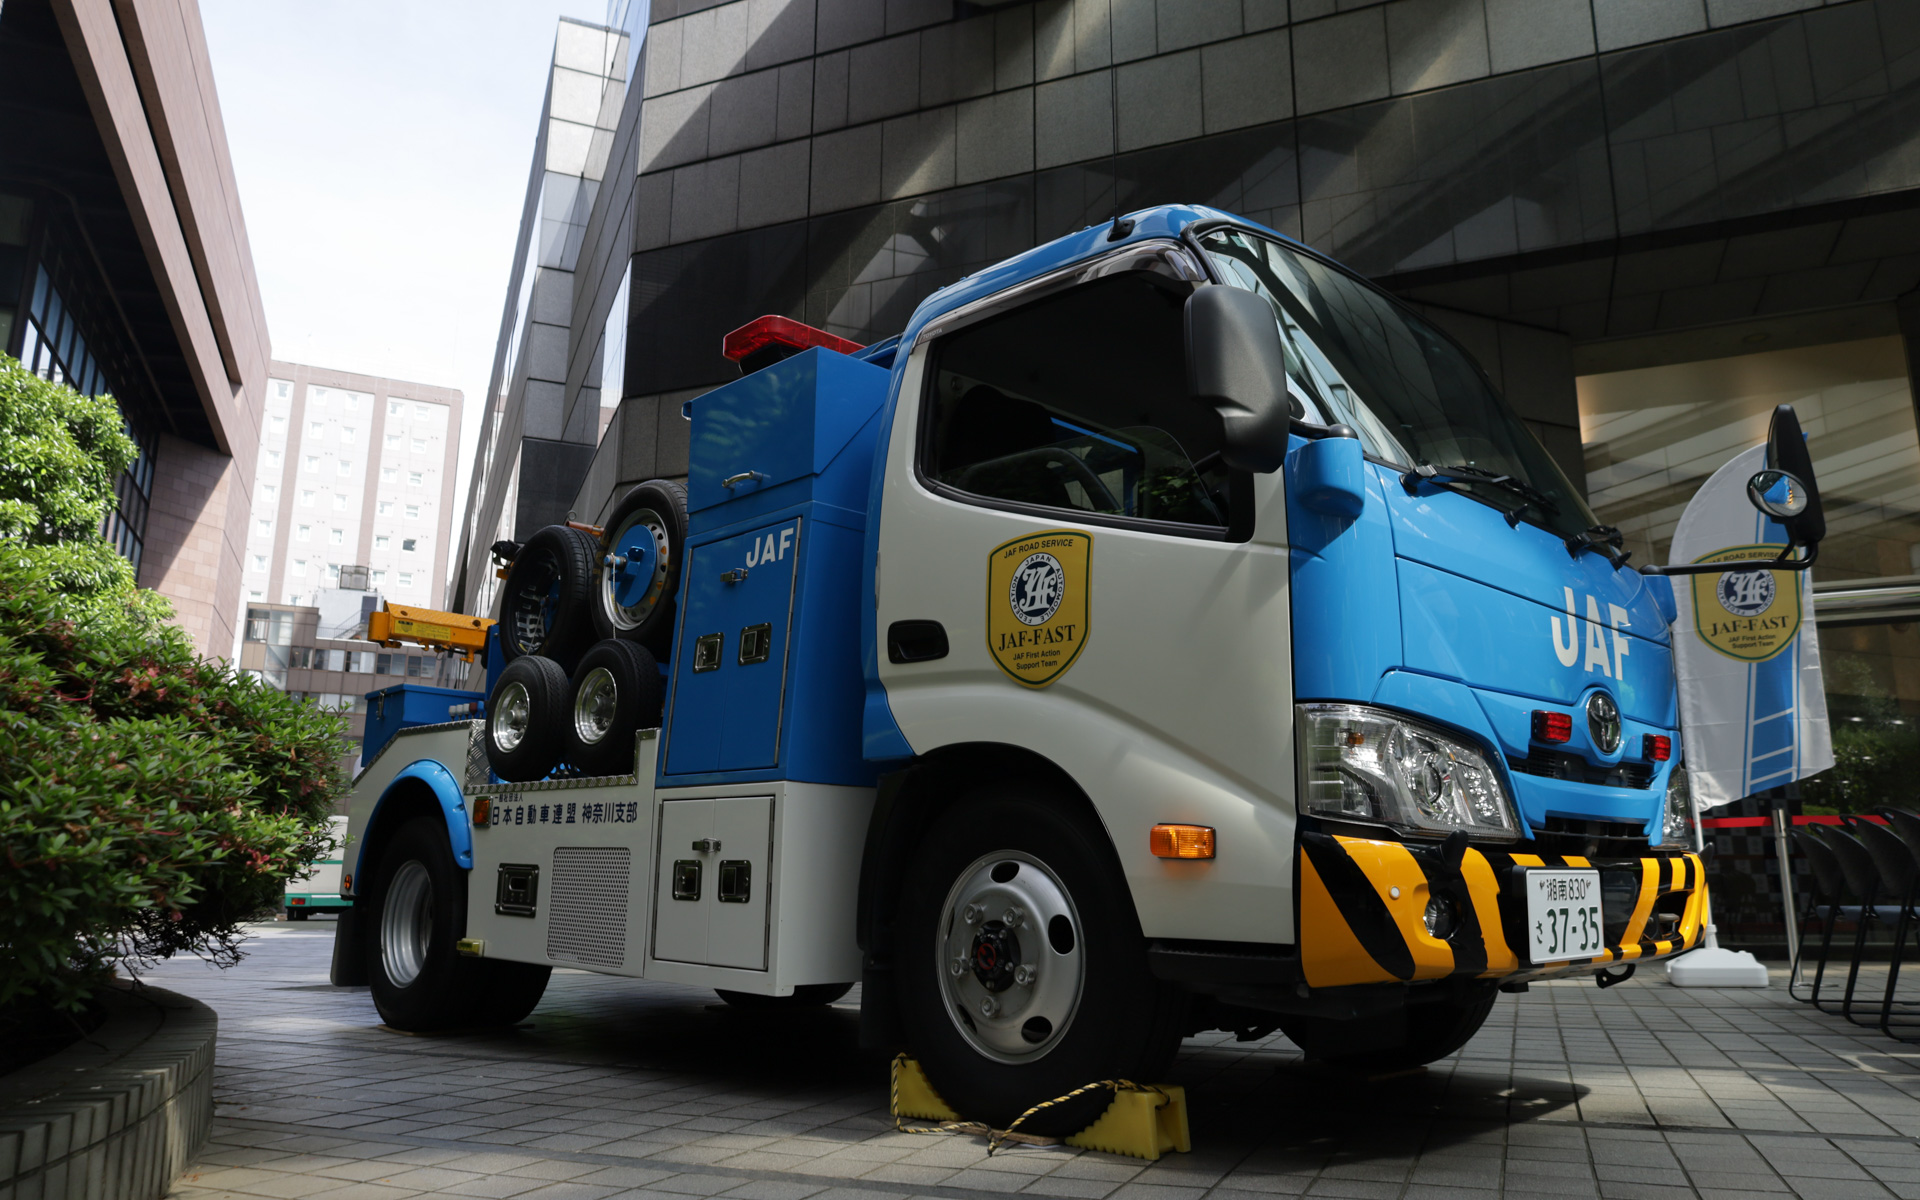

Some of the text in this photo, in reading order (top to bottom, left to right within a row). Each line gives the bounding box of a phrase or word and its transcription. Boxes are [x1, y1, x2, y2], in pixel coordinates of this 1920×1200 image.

[745, 527, 794, 568] JAF
[1004, 538, 1074, 559] JAF ROAD SERVICE
[1723, 552, 1746, 561] ROAD
[1010, 555, 1063, 623] JAPAN AUTOMOBILE FEDERATION
[998, 624, 1076, 652] JAF-FAST
[1550, 586, 1630, 681] JAF
[1710, 616, 1790, 637] JAF-FAST
[1013, 648, 1061, 661] JAF First Action
[1016, 661, 1040, 670] Support
[492, 801, 638, 826] 日本自動車連盟 神奈川支部
